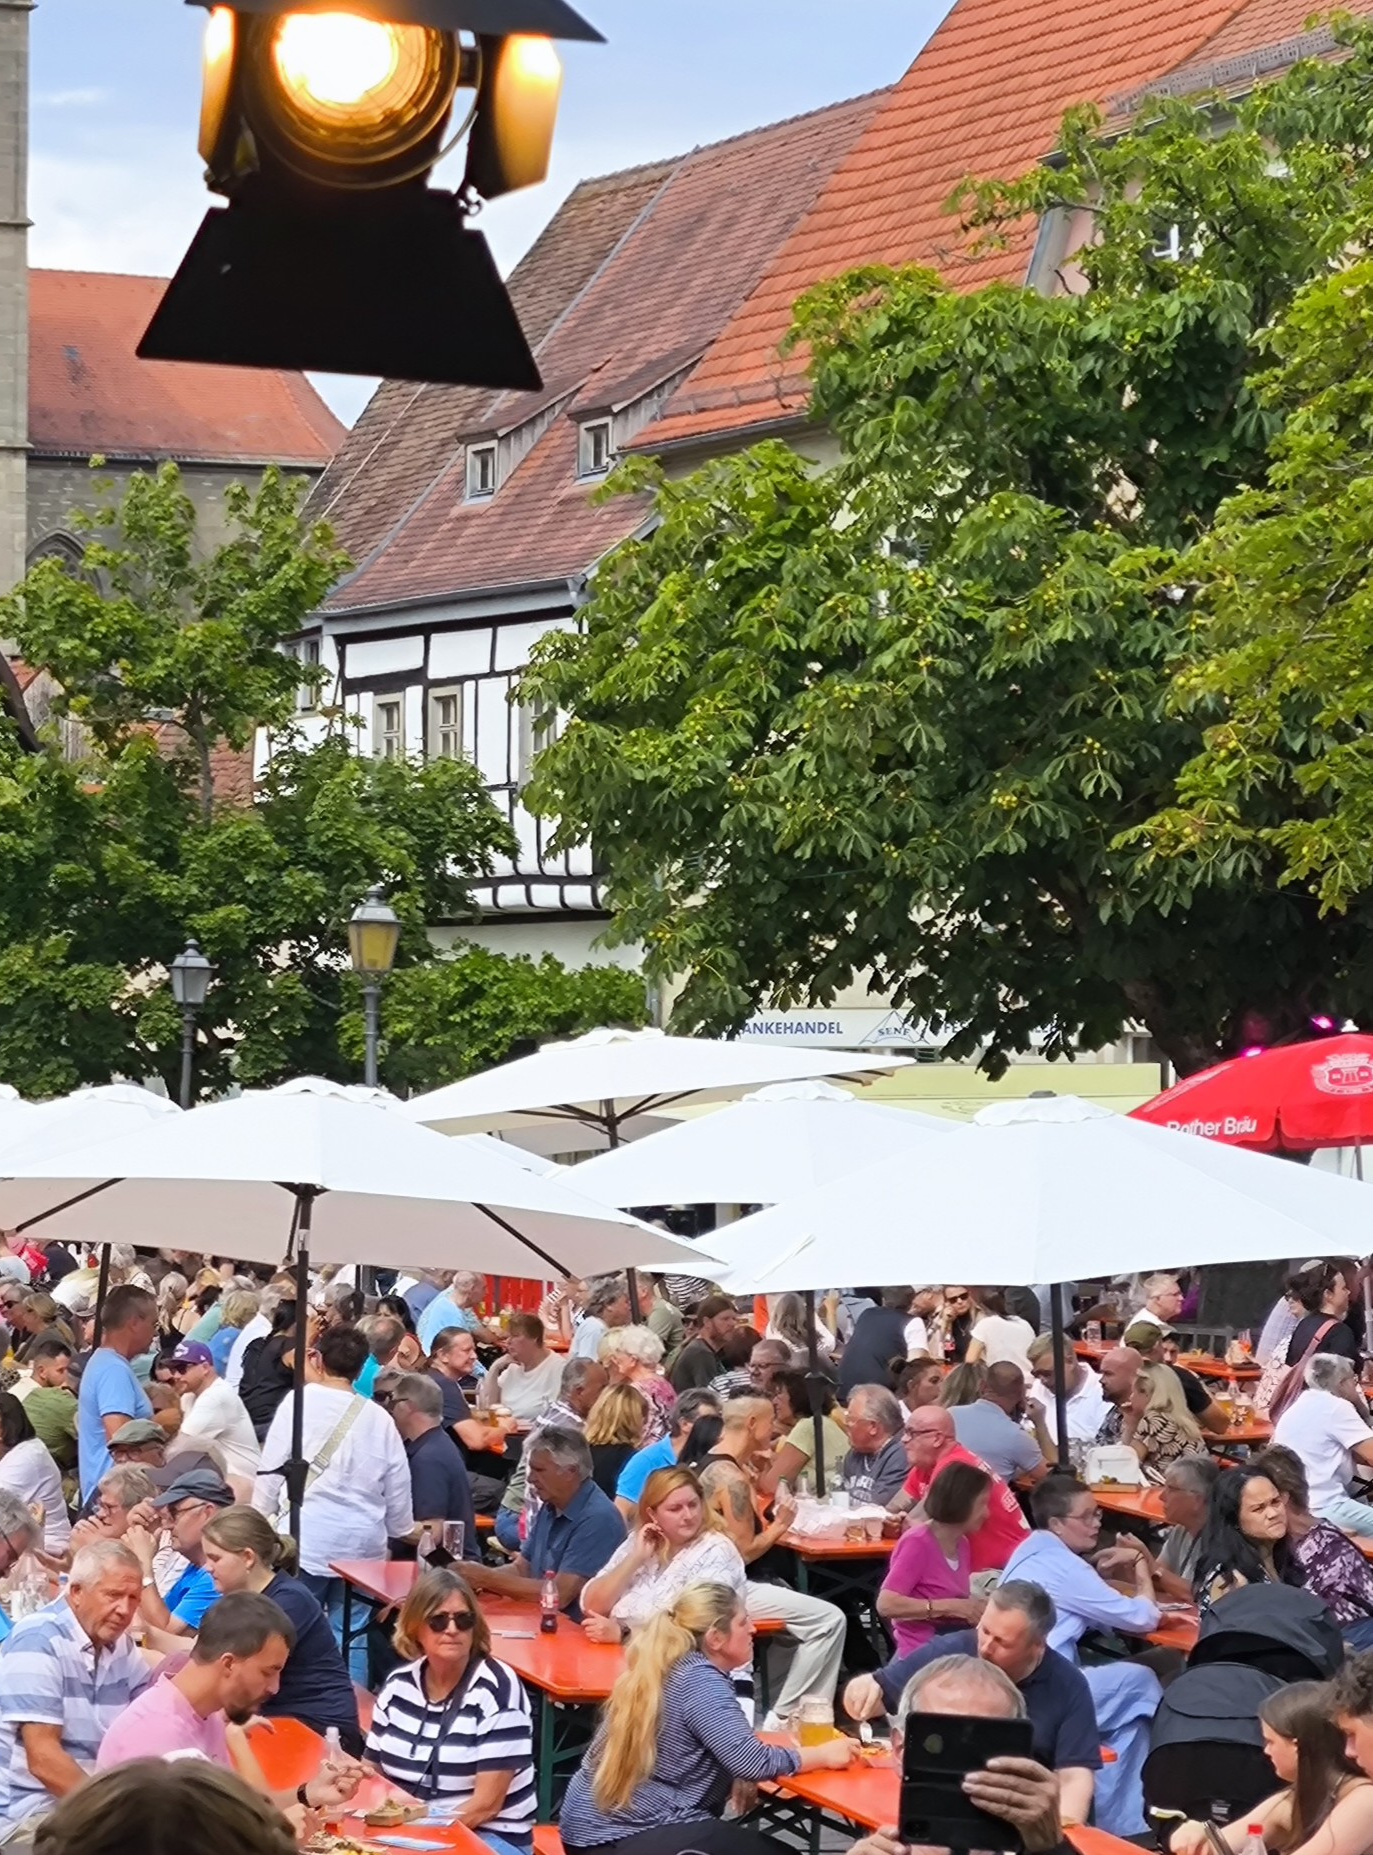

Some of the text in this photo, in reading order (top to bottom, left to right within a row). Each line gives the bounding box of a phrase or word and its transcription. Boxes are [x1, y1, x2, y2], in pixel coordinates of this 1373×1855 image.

[742, 1021, 844, 1035] ANKEHANDEL
[877, 1026, 911, 1037] SENF
[1224, 1115, 1258, 1136] Bräu
